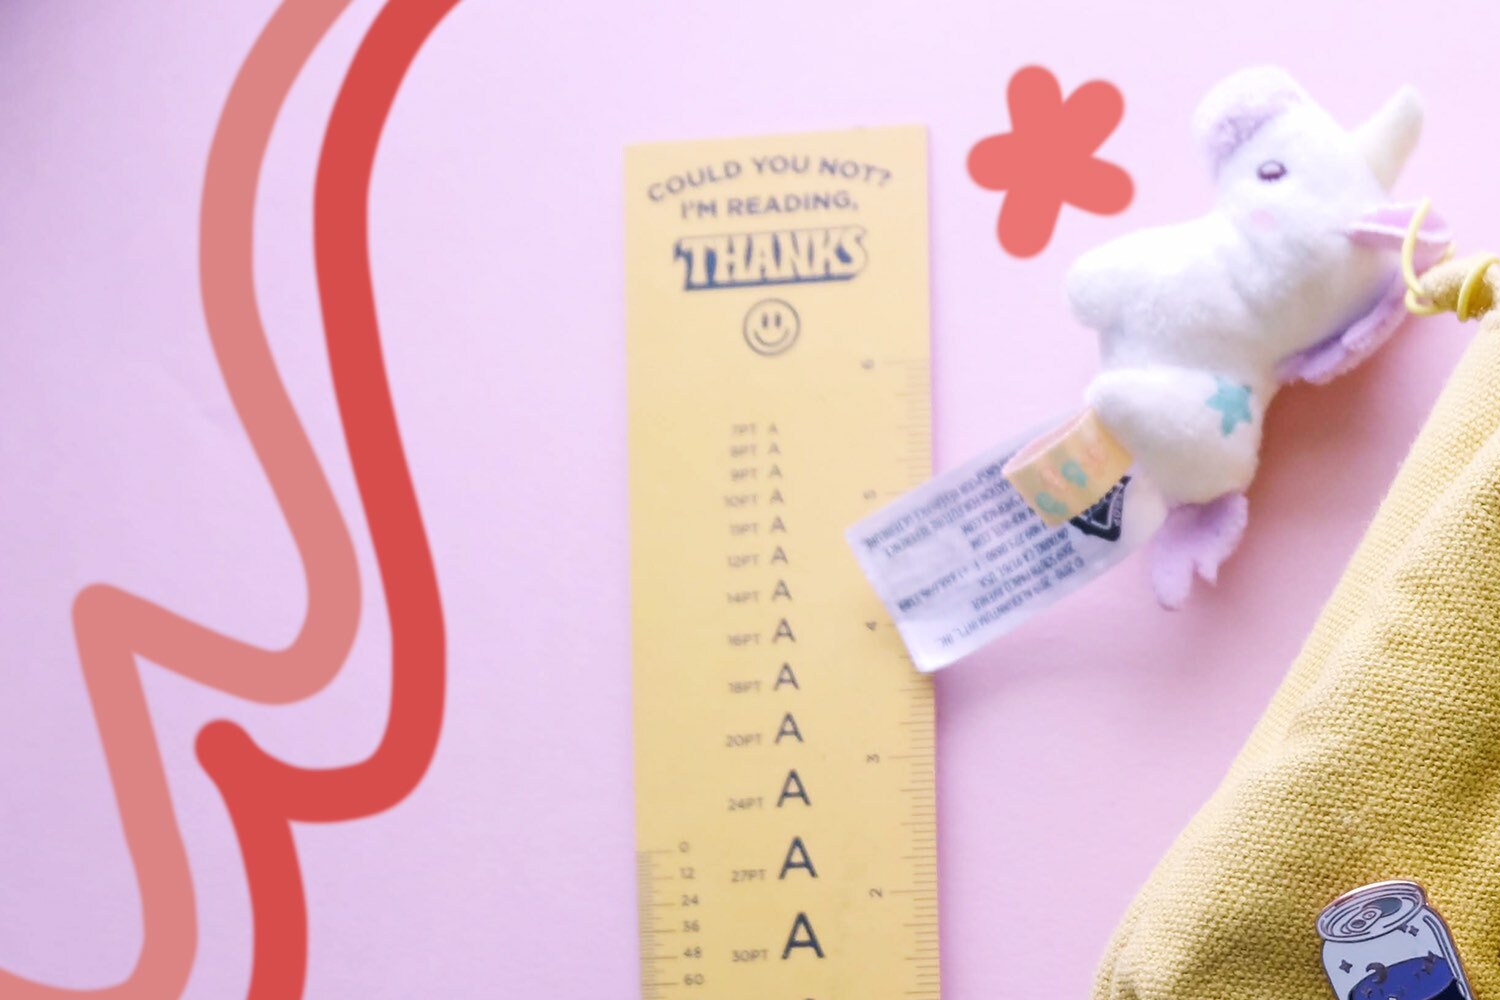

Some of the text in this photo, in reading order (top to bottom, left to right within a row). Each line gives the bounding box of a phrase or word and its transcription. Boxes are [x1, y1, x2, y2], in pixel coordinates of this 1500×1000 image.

[646, 154, 893, 203] COULD YOU NOT?
[680, 202, 718, 220] I'M
[673, 225, 869, 291] THANKS
[767, 441, 782, 455] A
[767, 463, 783, 479] A
[769, 487, 785, 505] A
[770, 545, 789, 565] A
[771, 579, 793, 603] A
[771, 617, 797, 644] A
[772, 662, 800, 692] A
[725, 712, 805, 748] 20PT A
[726, 768, 812, 812] 24PT A
[731, 836, 819, 884] 27PT A
[680, 867, 695, 880] 12
[681, 894, 699, 907] 24
[869, 887, 883, 899] 2
[682, 920, 700, 933] 36
[731, 911, 826, 964] 30PT A
[684, 946, 702, 959] 48
[684, 973, 705, 986] 60
